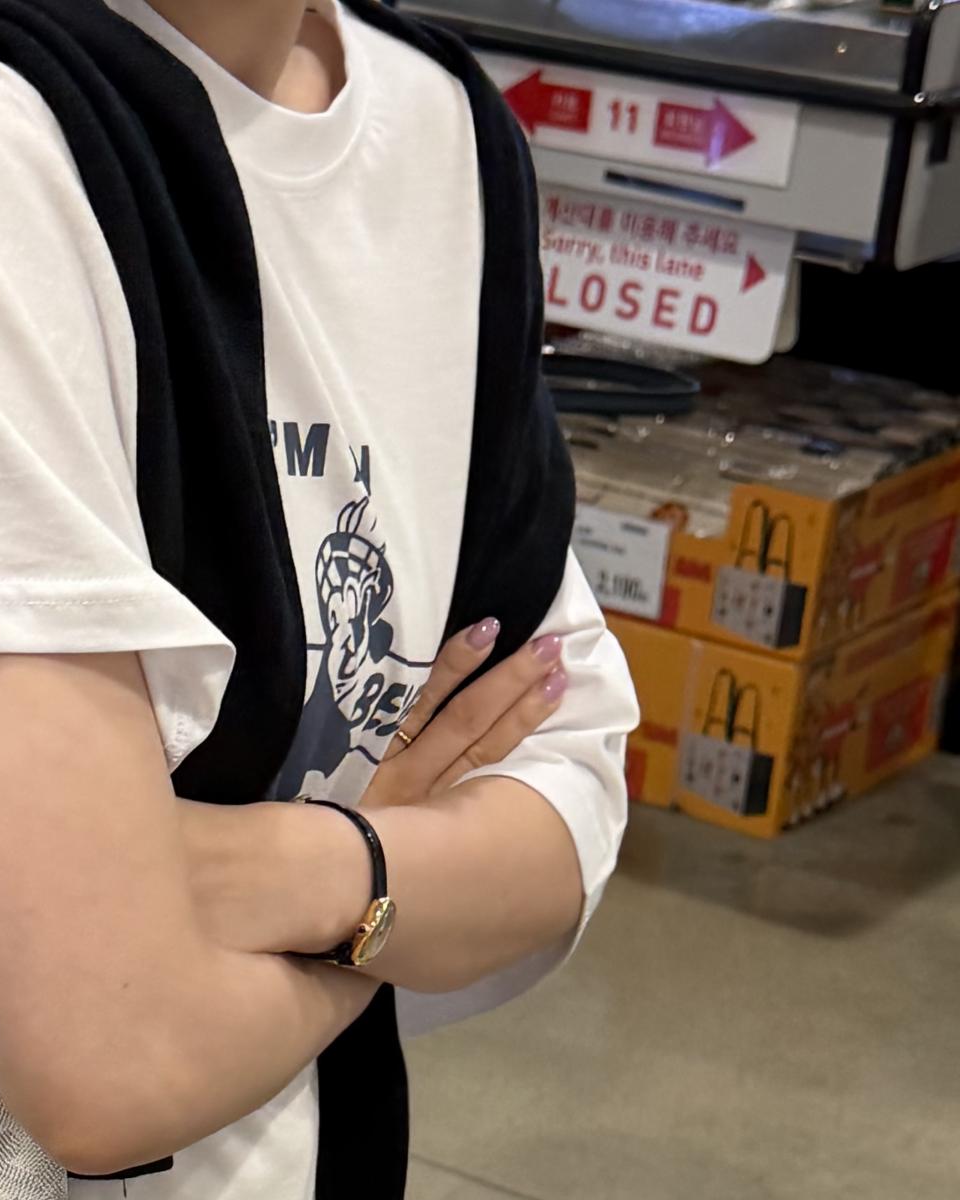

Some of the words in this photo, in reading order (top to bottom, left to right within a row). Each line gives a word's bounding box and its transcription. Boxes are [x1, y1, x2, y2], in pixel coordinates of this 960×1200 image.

[609, 98, 639, 135] 11
[620, 211, 680, 244] 이용해
[684, 222, 739, 255] 주세요
[609, 243, 650, 271] this
[655, 252, 706, 281] lane
[545, 265, 720, 336] LOSED
